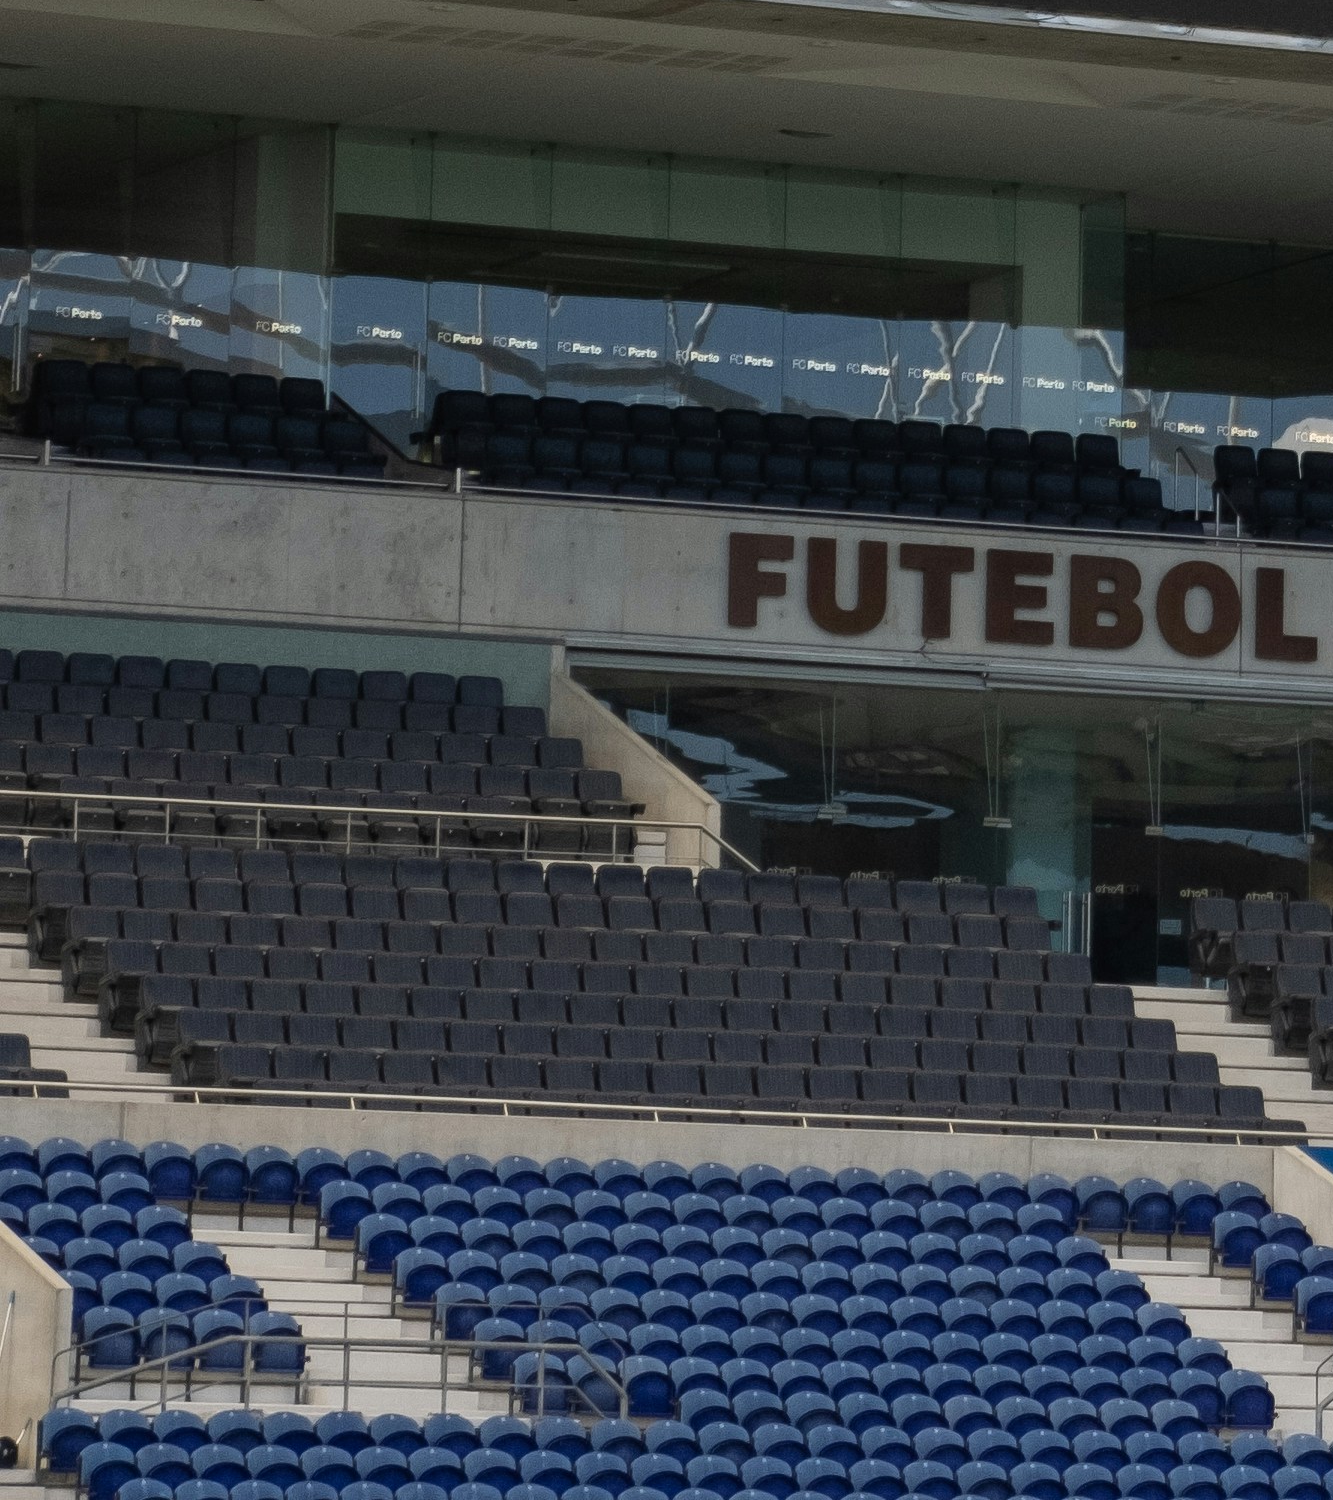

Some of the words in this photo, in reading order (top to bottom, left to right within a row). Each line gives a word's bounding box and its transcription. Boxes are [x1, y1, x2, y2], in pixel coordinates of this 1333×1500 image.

[72, 308, 102, 320] Porto
[172, 316, 201, 327] Porto
[272, 323, 301, 334] Porto
[372, 327, 402, 339] Porto
[453, 334, 482, 345] Porto
[508, 338, 537, 349] Porto
[573, 343, 602, 355] Porto
[628, 347, 657, 358] Porto
[745, 356, 773, 367] Porto
[808, 361, 835, 372] Porto
[861, 365, 889, 376] Porto
[1087, 382, 1114, 393] Porto
[1178, 423, 1204, 434] Porto
[1231, 427, 1257, 438] Porto
[728, 532, 1318, 662] FUTEBOL
